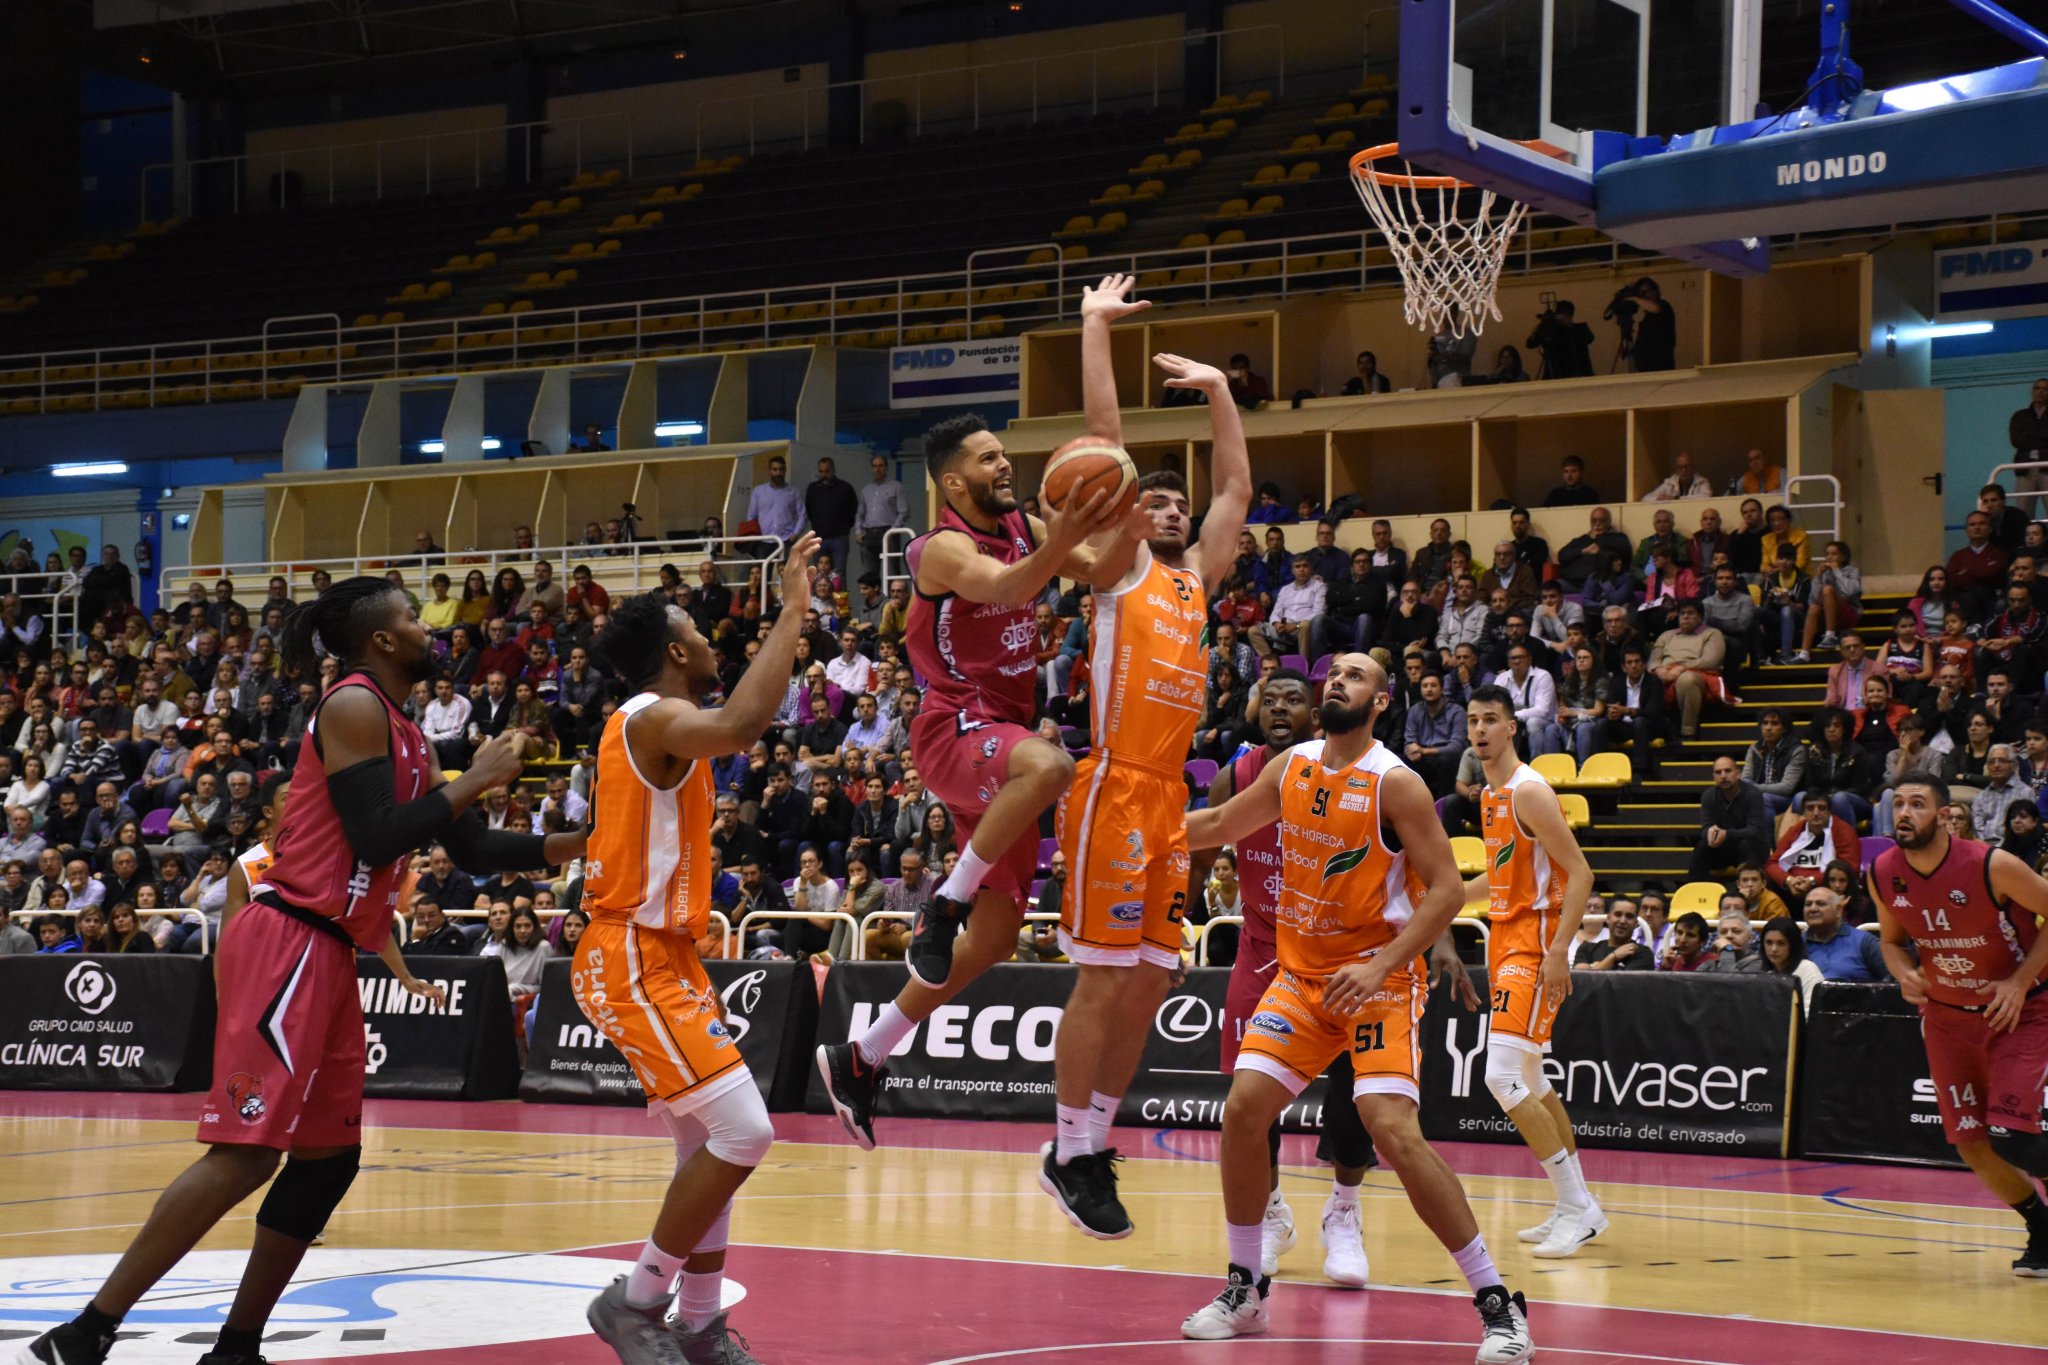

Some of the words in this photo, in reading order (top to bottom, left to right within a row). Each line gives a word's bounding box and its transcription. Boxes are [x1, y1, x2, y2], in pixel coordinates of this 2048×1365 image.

[1777, 151, 1887, 186] MONDO
[1940, 247, 2033, 279] FMD
[892, 347, 956, 371] FMD
[983, 356, 999, 365] de
[1310, 786, 1332, 818] 51
[1301, 827, 1346, 849] HORECA
[1921, 908, 1952, 932] 14
[1493, 988, 1511, 1013] 21
[28, 1019, 68, 1032] GRUPO
[69, 1020, 95, 1032] CMD
[96, 1020, 133, 1034] SALUD
[1354, 1021, 1385, 1054] 51
[0, 1037, 87, 1066] CLÍNICA
[97, 1045, 145, 1068] SUR
[550, 1058, 579, 1071] Bienes
[581, 1060, 594, 1072] de
[595, 1061, 628, 1076] equipo,
[885, 1075, 914, 1092] para
[918, 1074, 931, 1089] el
[934, 1077, 1004, 1095] transporte
[1007, 1079, 1057, 1095] sosteni
[1544, 1058, 1768, 1111] envaser
[1949, 1082, 1978, 1109] 14
[1638, 1124, 1664, 1140] del
[1670, 1128, 1746, 1145] envasado
